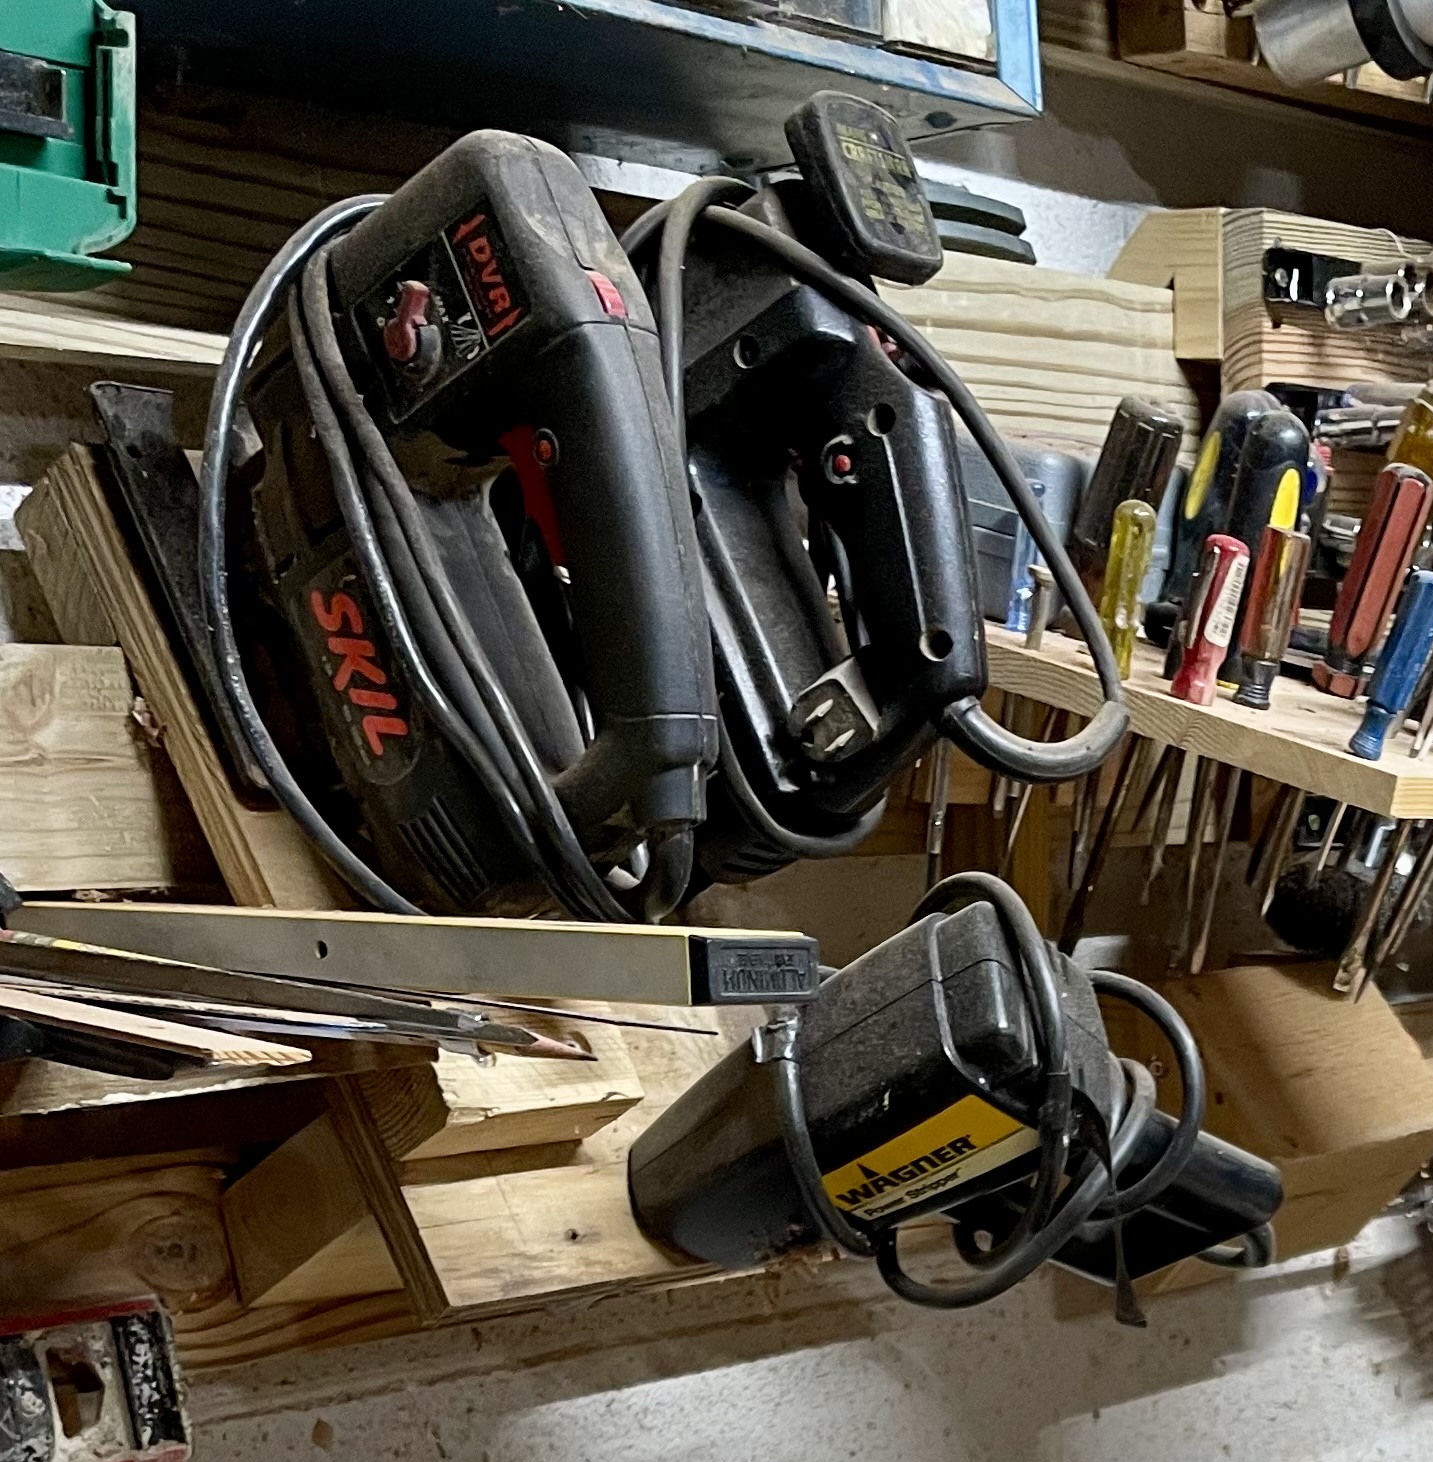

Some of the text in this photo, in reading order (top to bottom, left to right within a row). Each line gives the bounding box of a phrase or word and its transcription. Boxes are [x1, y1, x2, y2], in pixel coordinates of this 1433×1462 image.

[469, 237, 511, 313] DVR
[311, 589, 408, 756] SKIL
[835, 1136, 977, 1206] WAGNER
[905, 1167, 961, 1198] Stripper
